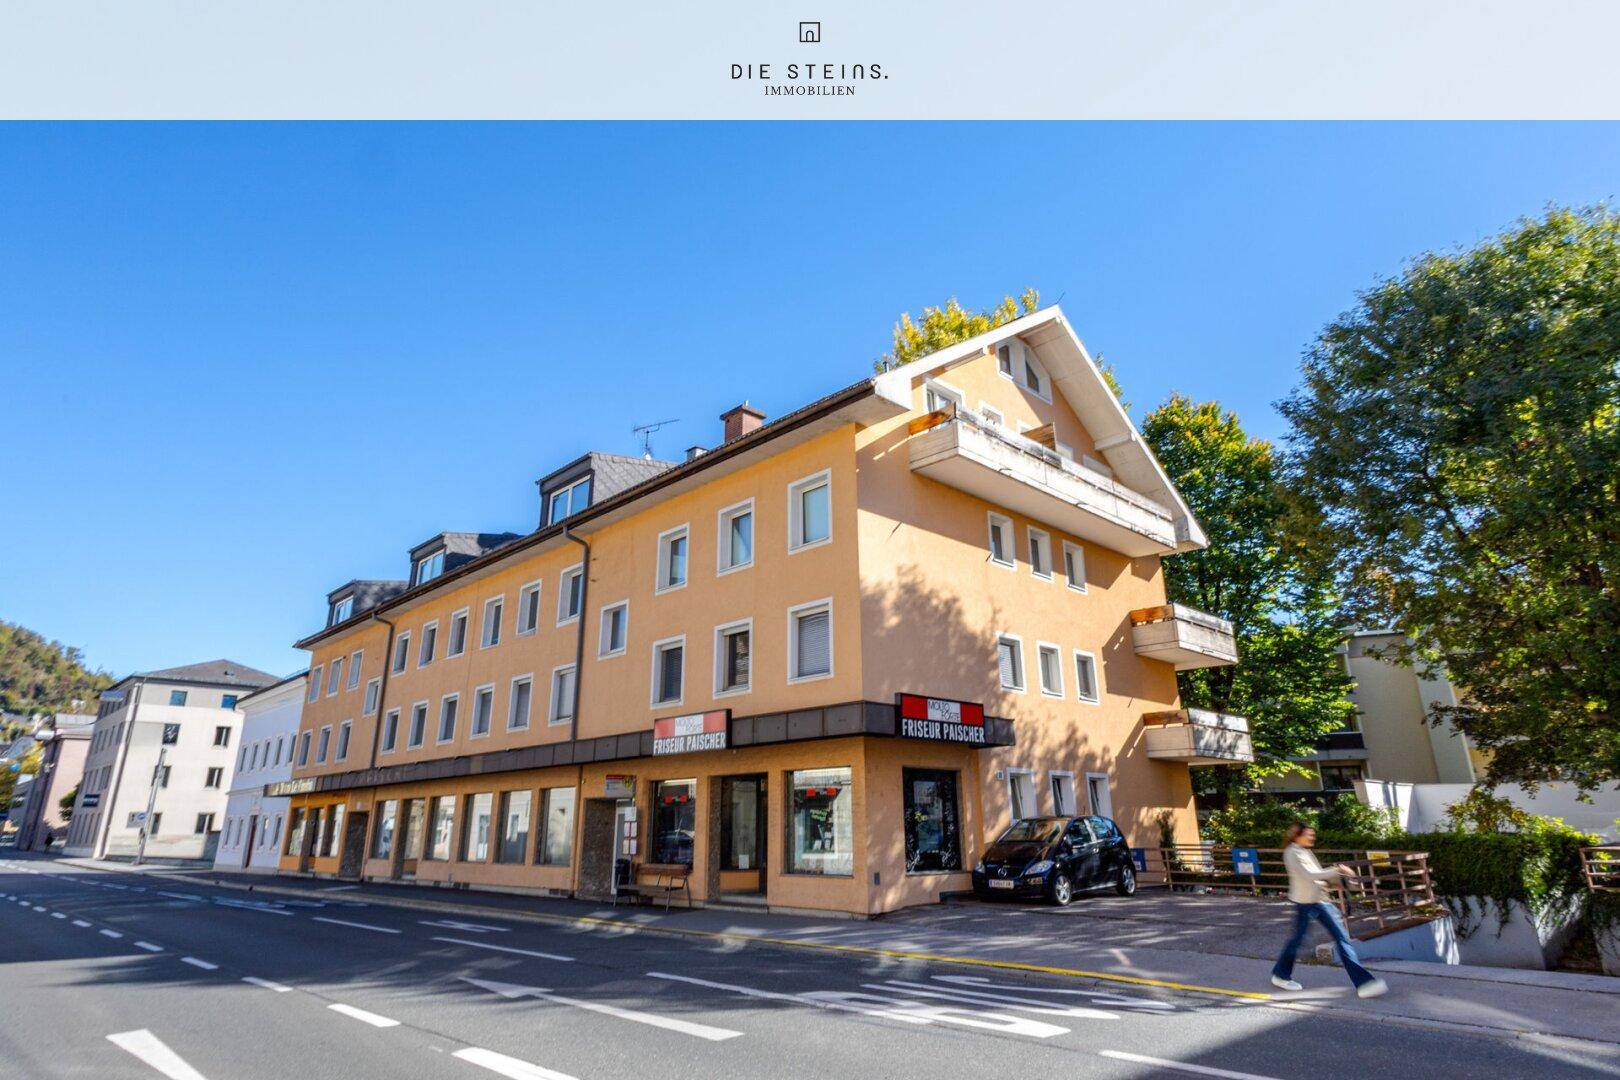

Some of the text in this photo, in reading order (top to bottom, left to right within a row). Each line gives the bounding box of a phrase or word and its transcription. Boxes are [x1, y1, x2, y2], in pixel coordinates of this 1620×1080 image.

[902, 718, 986, 743] FRISEUR PAISCHER
[653, 731, 727, 755] FRISEUR PAISCHER
